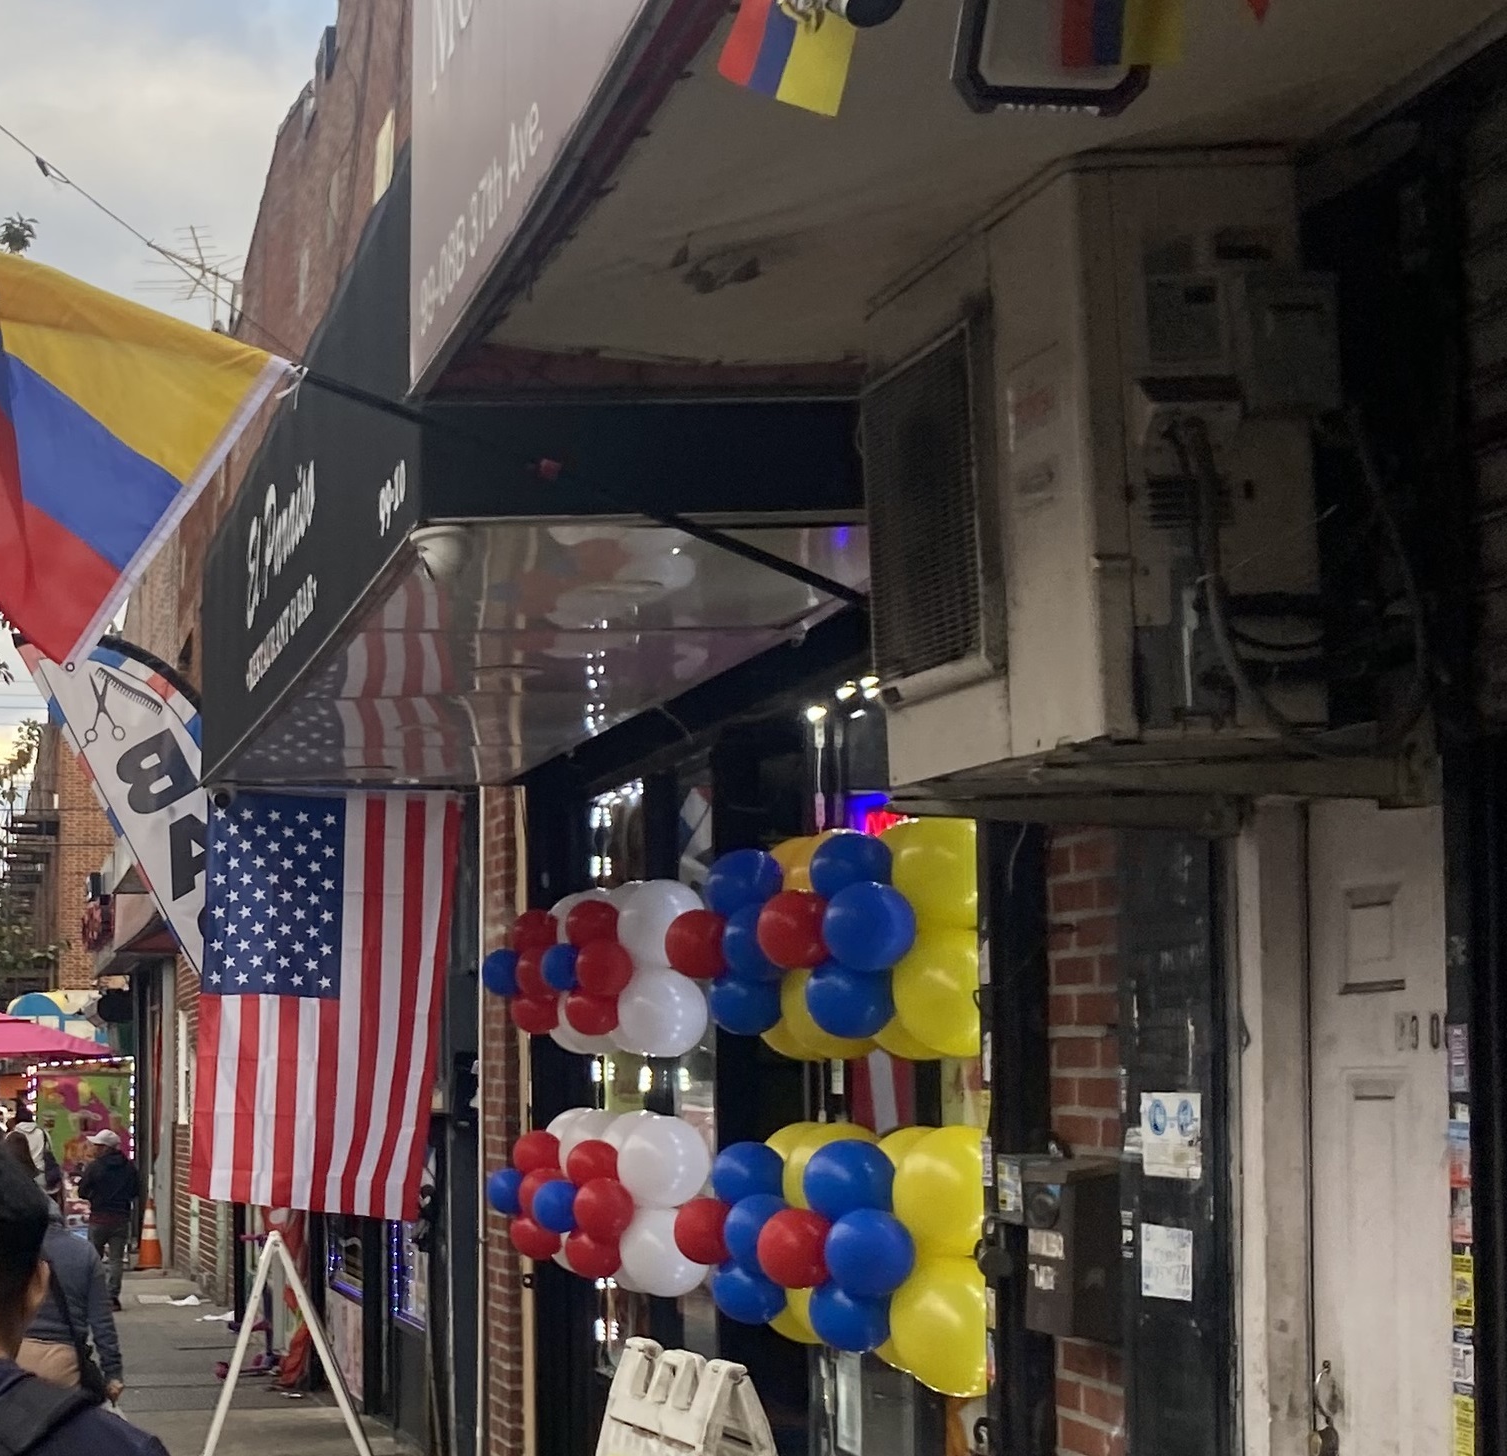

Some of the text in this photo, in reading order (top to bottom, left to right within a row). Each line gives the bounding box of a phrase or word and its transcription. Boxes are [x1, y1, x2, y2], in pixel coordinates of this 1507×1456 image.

[468, 156, 503, 258] 37th
[506, 102, 544, 199] Ave.
[247, 515, 263, 630] El
